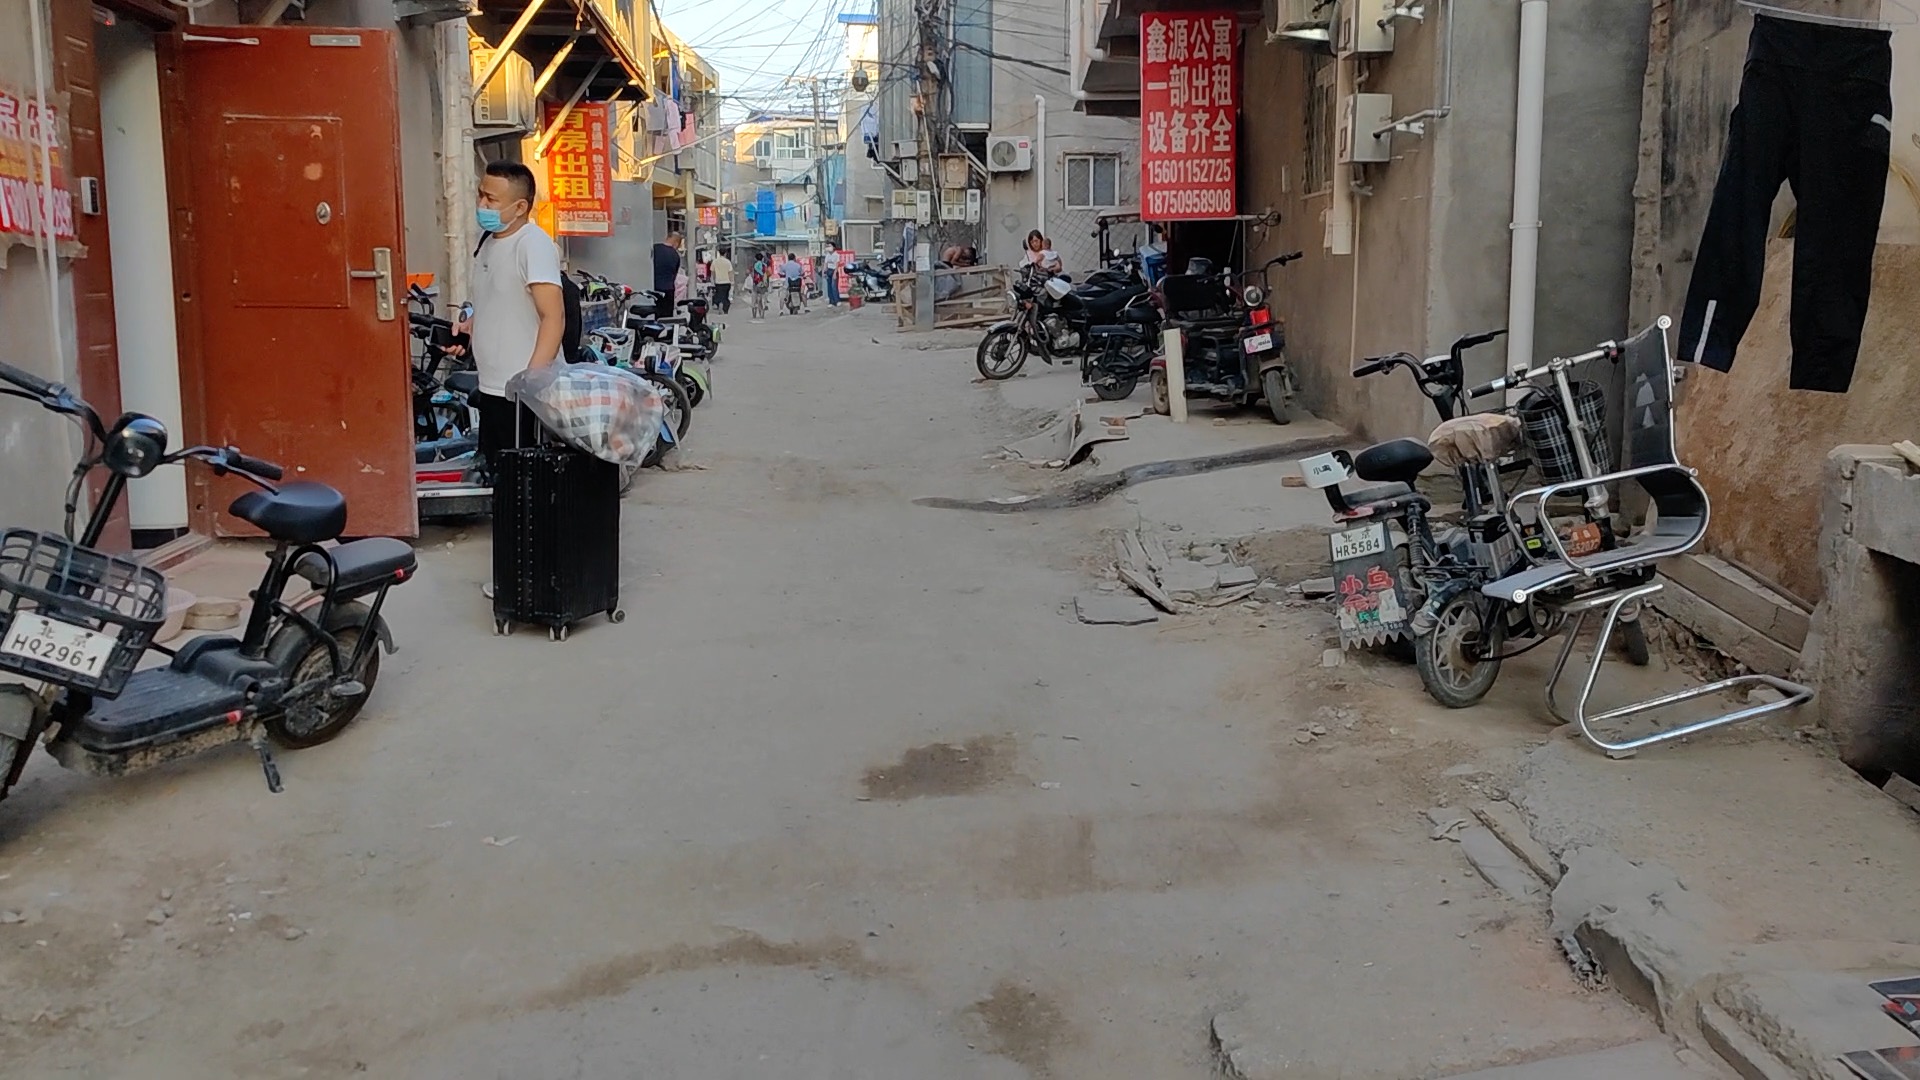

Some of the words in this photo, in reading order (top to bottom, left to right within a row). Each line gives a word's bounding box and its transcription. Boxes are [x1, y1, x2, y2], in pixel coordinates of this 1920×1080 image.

[1146, 16, 1233, 64] 鑫源公寓
[1146, 63, 1233, 109] 一部出租
[1147, 108, 1233, 154] 设备齐全
[552, 108, 593, 199] 有房出租
[1147, 158, 1232, 185] 15601152725
[1147, 188, 1232, 215] 18750958908
[1335, 537, 1380, 558] HR5584
[1339, 565, 1395, 595] 小鸟
[10, 632, 98, 671] HQ2961
